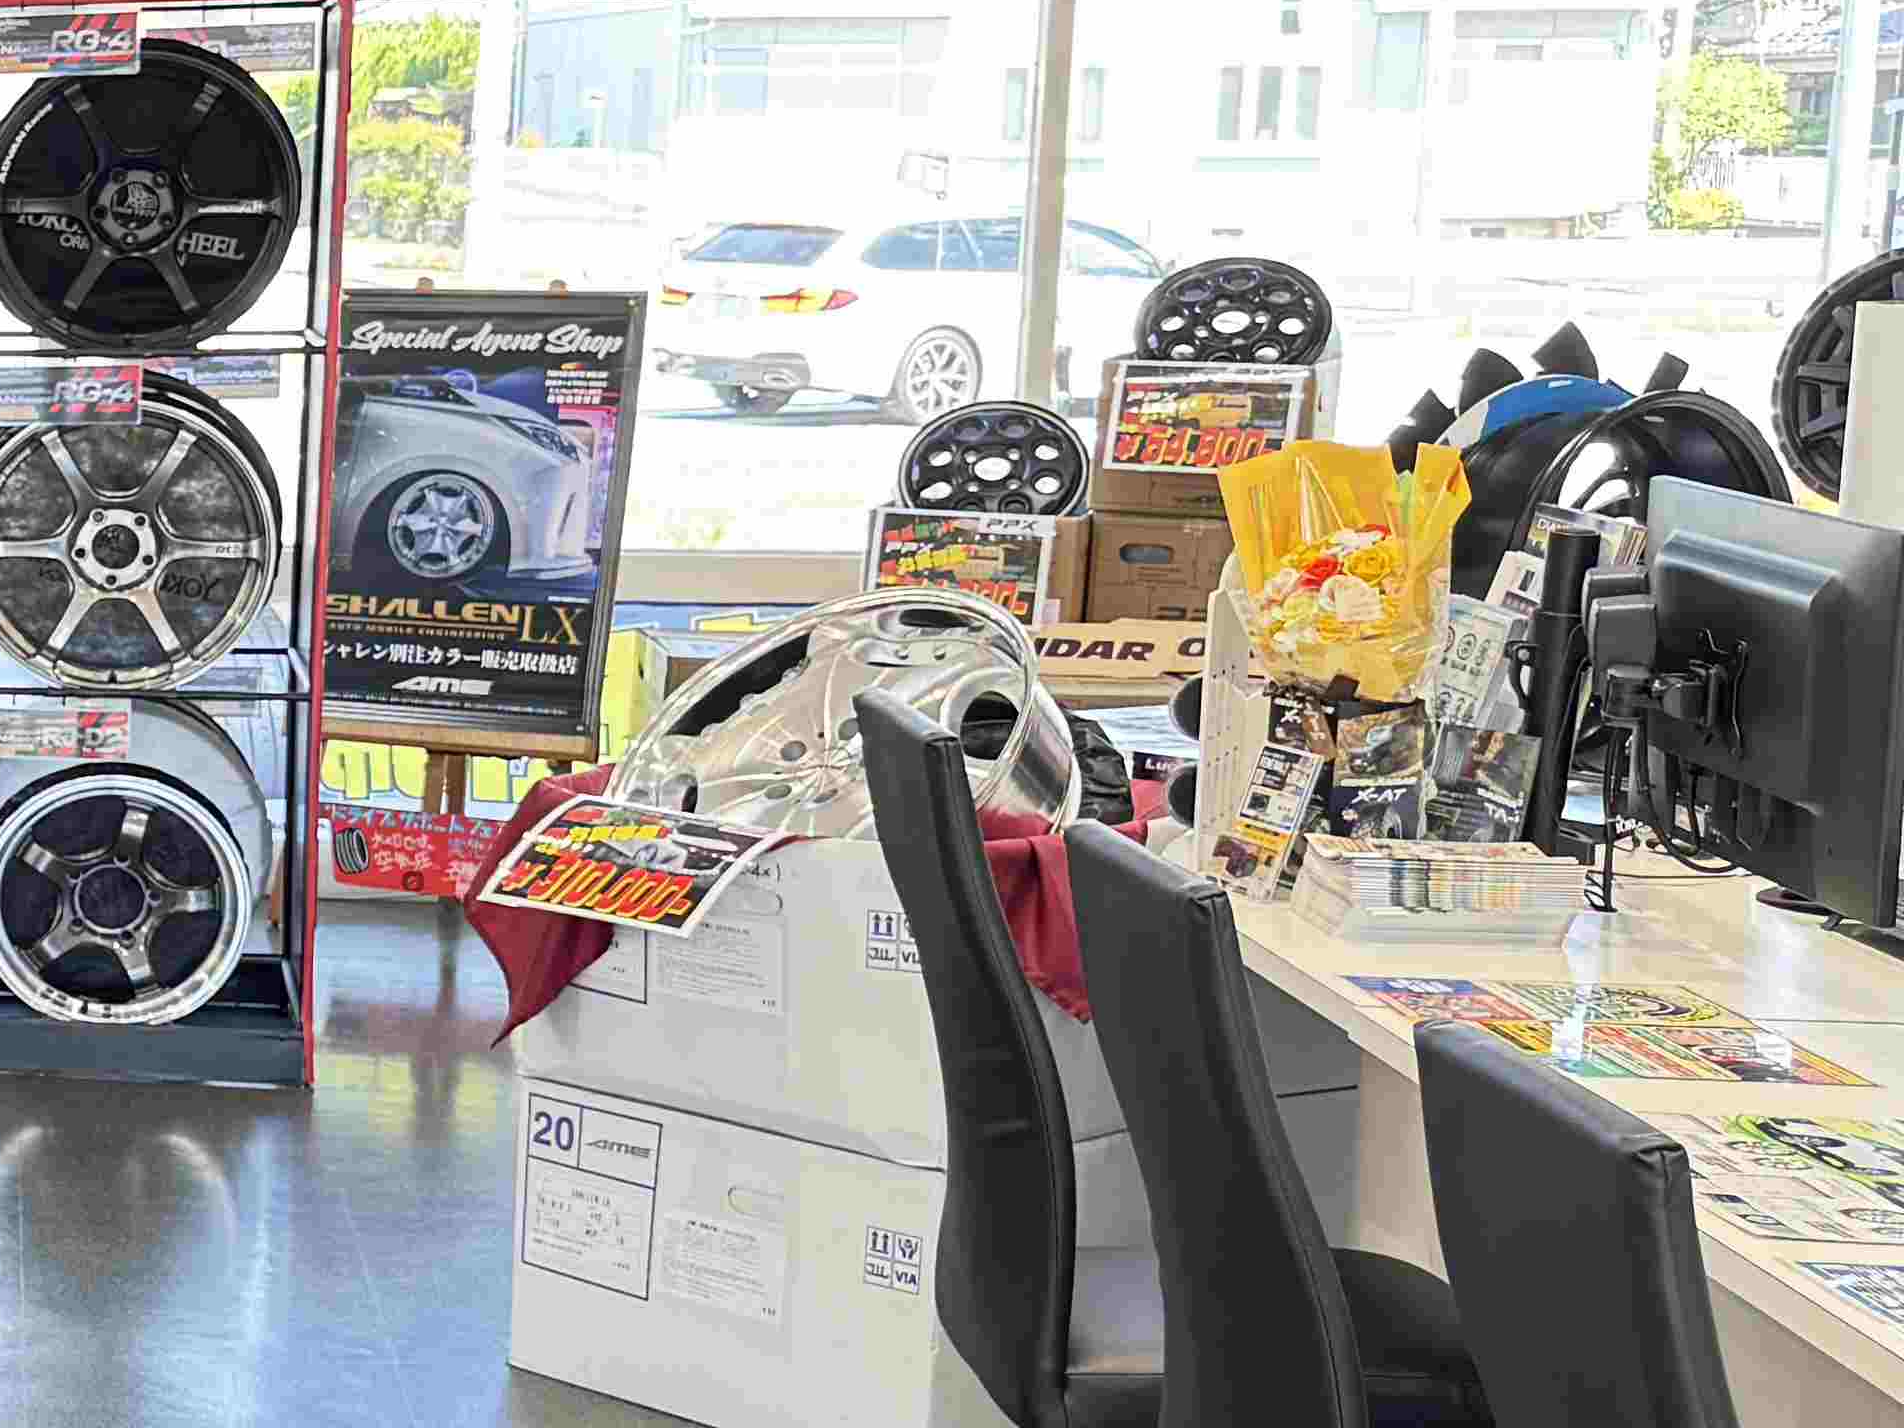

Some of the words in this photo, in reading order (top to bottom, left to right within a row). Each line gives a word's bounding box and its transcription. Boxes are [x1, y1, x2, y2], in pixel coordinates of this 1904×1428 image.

[349, 320, 453, 355] Special
[450, 323, 543, 358] Agent
[544, 322, 624, 359] Shop
[326, 594, 520, 624] SHALLEN
[520, 608, 583, 648] LX
[532, 1110, 575, 1152] 20
